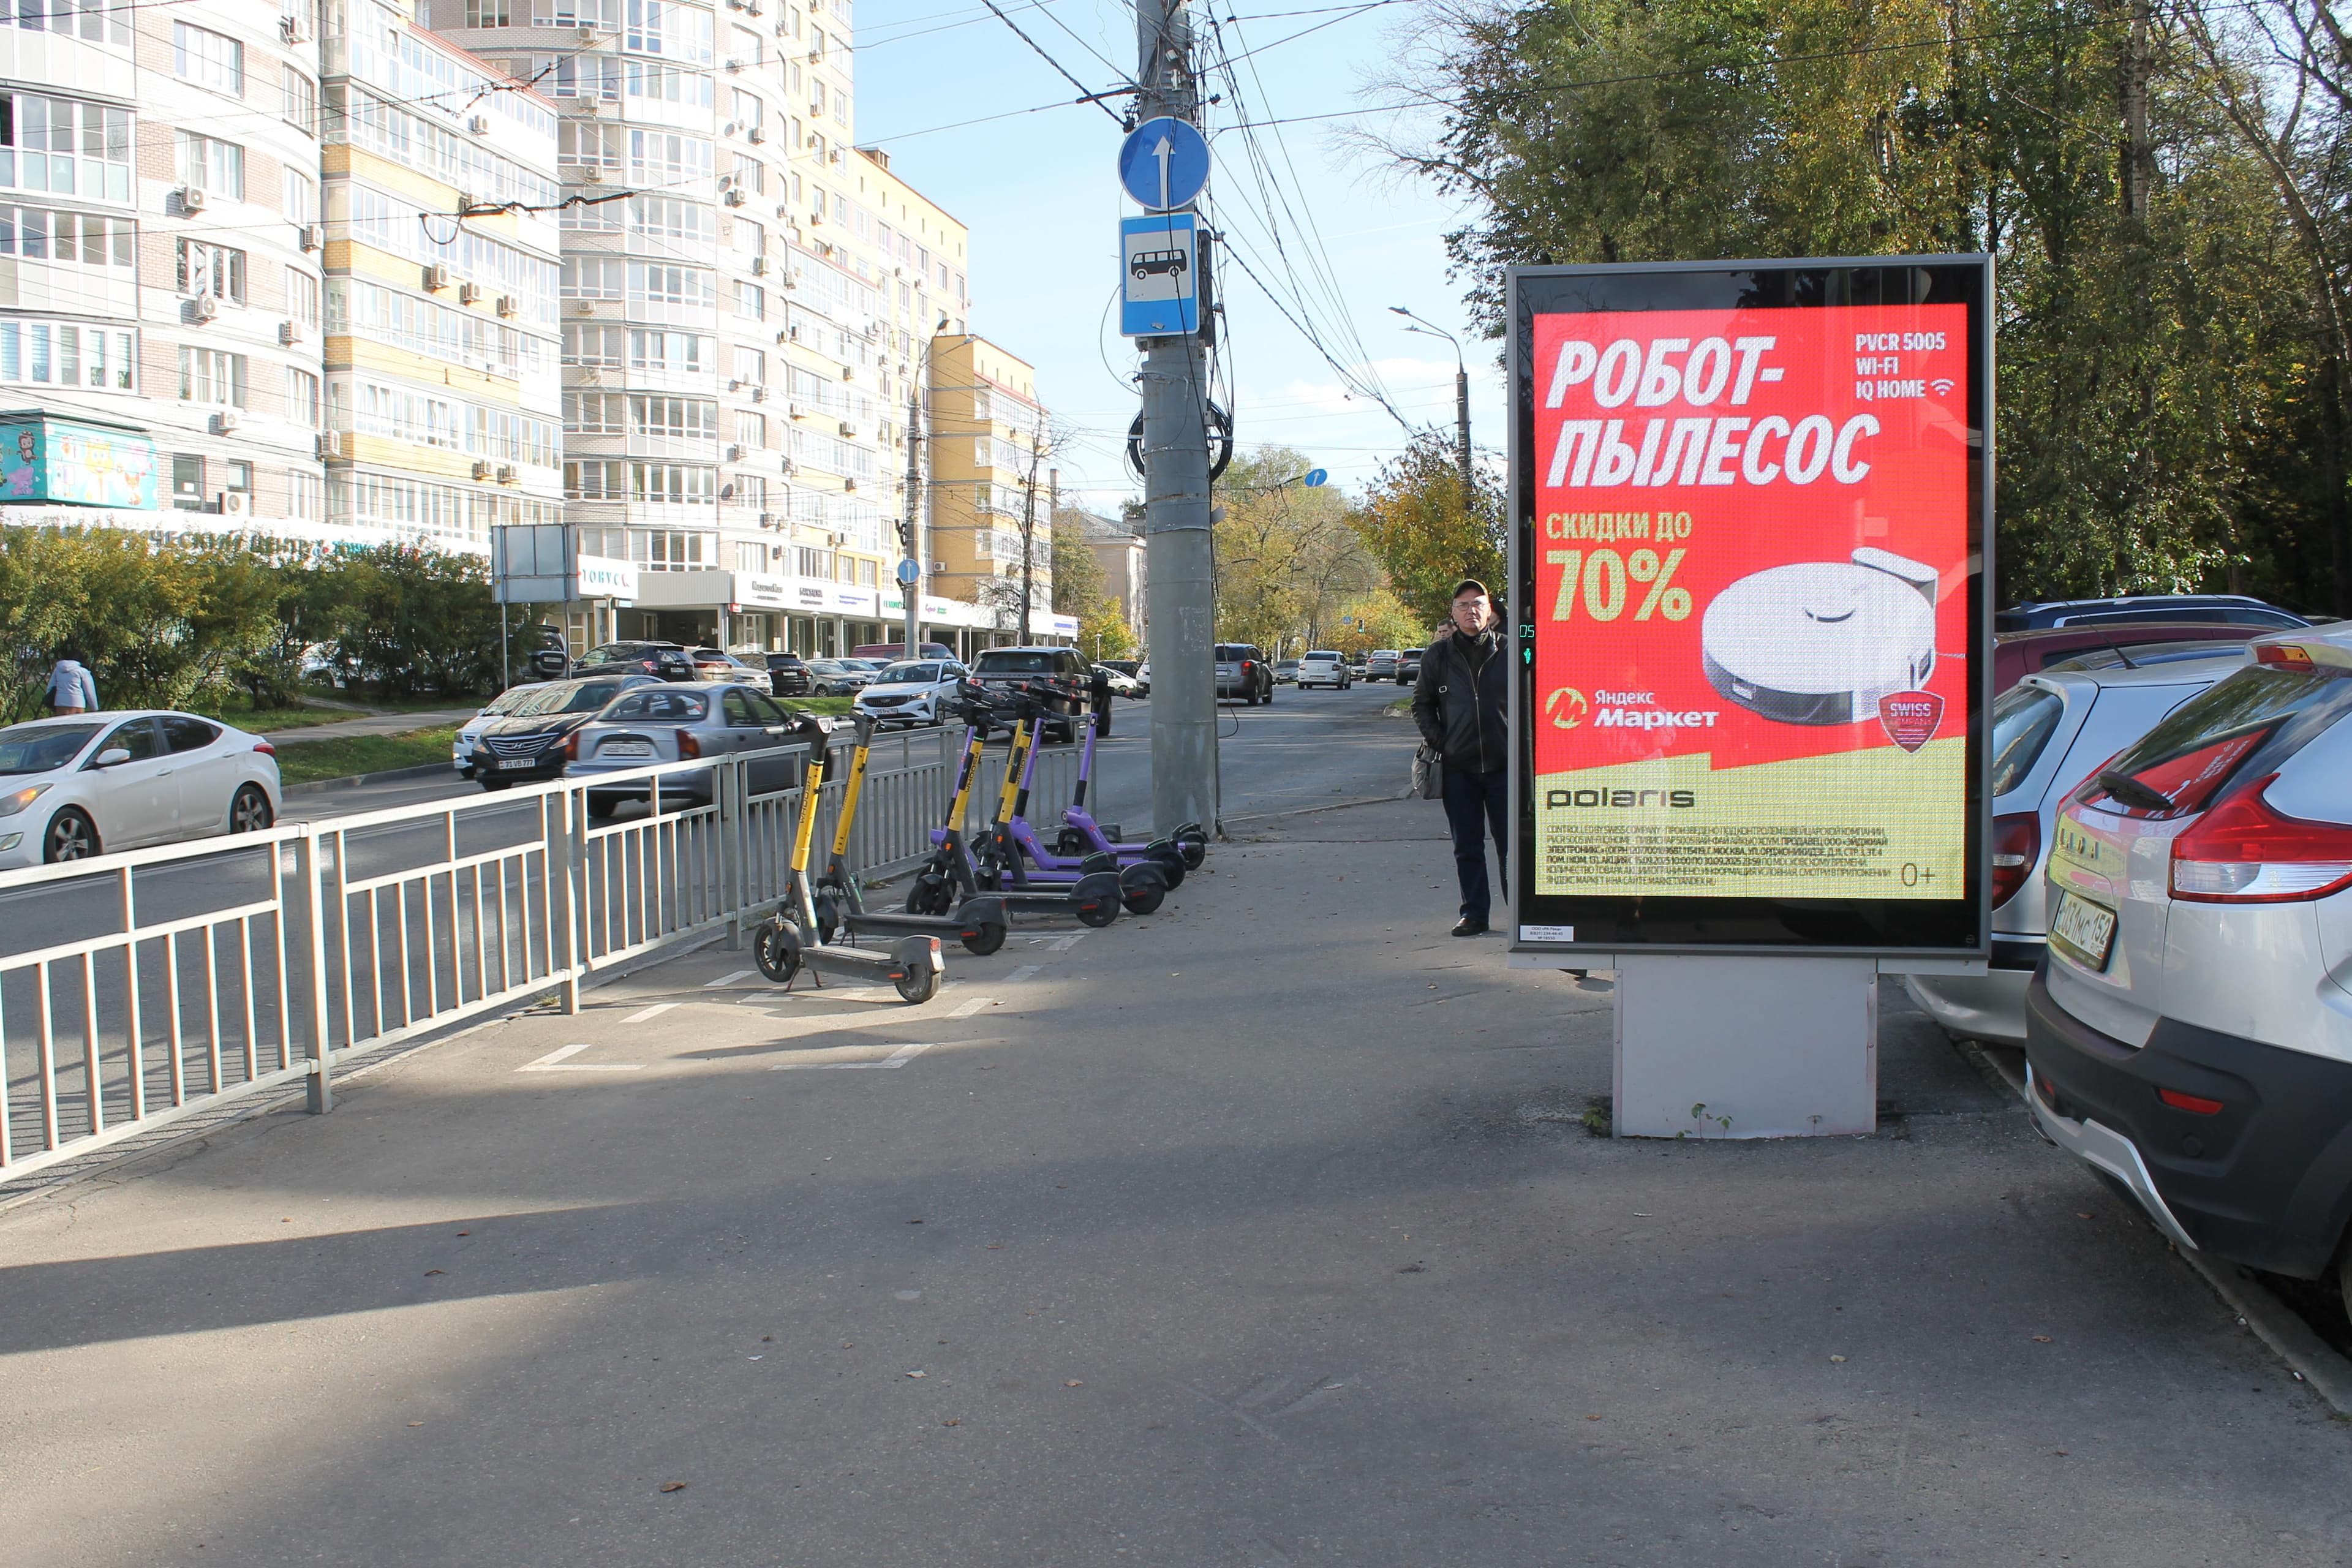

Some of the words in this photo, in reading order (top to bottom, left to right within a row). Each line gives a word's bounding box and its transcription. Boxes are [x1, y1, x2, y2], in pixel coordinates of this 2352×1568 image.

[1855, 333, 1899, 352] PVCR
[1902, 331, 1946, 351] 5005
[1545, 336, 1785, 409] РОБОТ-
[1856, 356, 1899, 375] WI-FI
[1856, 380, 1874, 401] IQ
[1877, 379, 1926, 399] HOME
[1545, 413, 1880, 488] ПЫЛЕСОС
[1546, 512, 1650, 543] СКИДКИ
[1655, 511, 1692, 543] ДО
[1547, 548, 1692, 622] 70%
[1519, 624, 1534, 638] 05
[1595, 690, 1655, 706] Яндекс
[1594, 708, 1719, 731] Маркет
[1890, 703, 1931, 717] SWISS
[965, 752, 979, 793] WHOOSH
[799, 775, 812, 823] WHOOSH
[1547, 787, 1694, 810] polaris
[1901, 862, 1936, 886] 0+
[2092, 911, 2111, 945] 152
